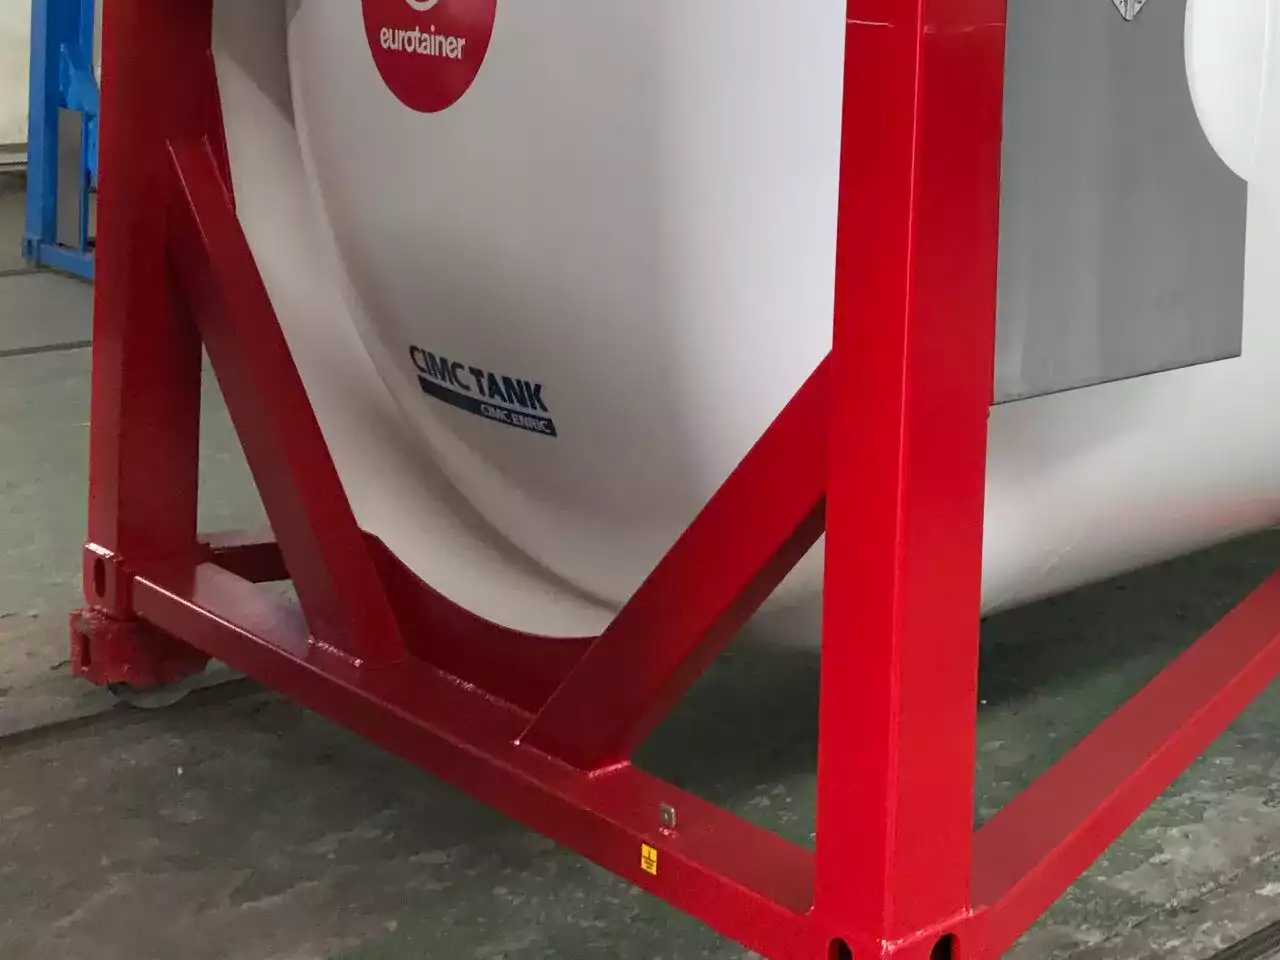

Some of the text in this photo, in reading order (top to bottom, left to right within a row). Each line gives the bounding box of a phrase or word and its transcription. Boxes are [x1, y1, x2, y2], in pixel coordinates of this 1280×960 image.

[380, 24, 466, 60] eurotainer
[409, 344, 549, 412] CIMC TANK
